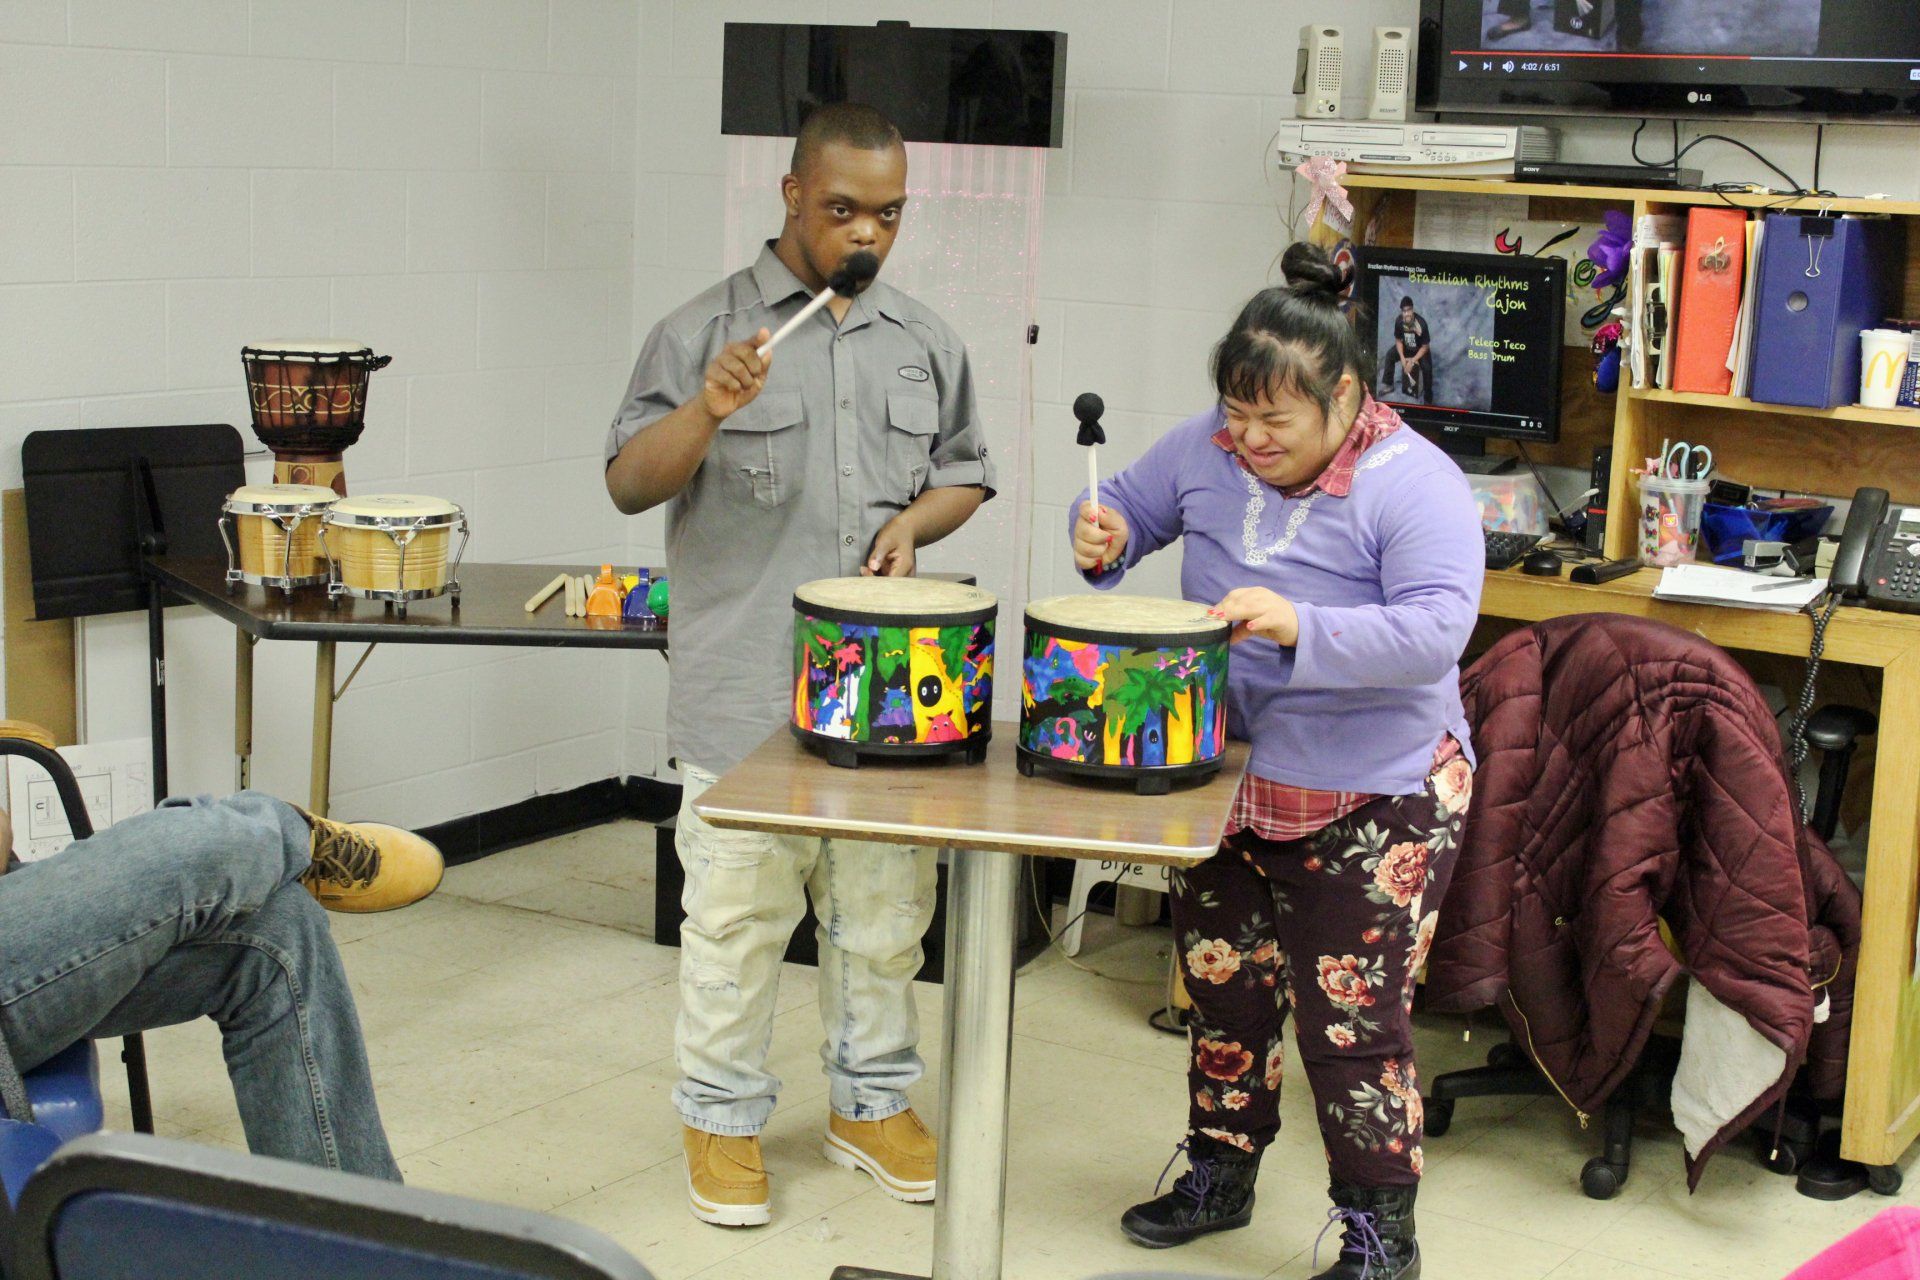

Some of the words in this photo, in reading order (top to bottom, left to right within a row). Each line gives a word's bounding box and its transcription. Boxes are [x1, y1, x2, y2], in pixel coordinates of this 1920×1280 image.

[1521, 63, 1538, 71] 4:02
[1544, 63, 1560, 71] 6:51
[1408, 271, 1469, 287] Brazilian
[1474, 275, 1529, 295] Rhythms
[1485, 294, 1526, 315] Cajon
[1468, 336, 1500, 348] Teleco
[1503, 339, 1526, 351] Teco
[1467, 349, 1488, 360] Bass
[1491, 351, 1515, 363] Drum
